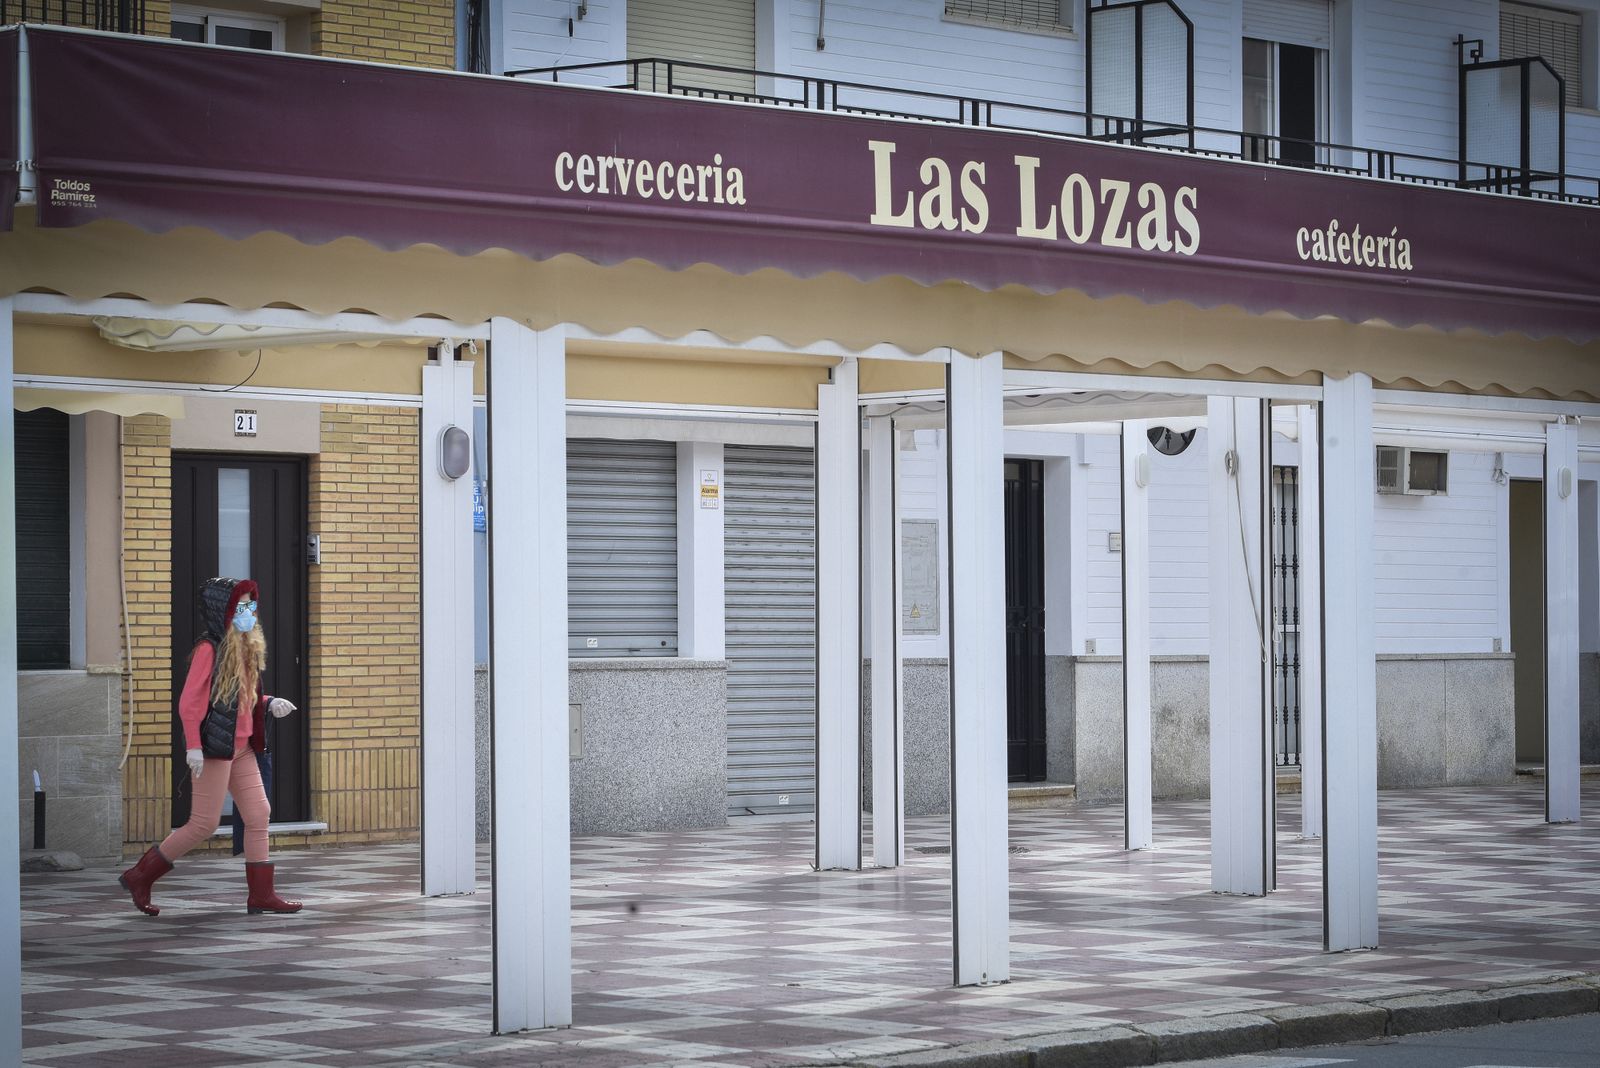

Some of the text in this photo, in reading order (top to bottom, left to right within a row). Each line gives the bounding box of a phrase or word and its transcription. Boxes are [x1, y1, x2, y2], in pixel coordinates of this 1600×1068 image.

[54, 179, 90, 191] Toldos
[555, 151, 747, 206] cerveceria
[51, 190, 95, 202] Ramírez
[868, 140, 1201, 256] Las Lozas
[1296, 219, 1413, 271] cafetería
[237, 415, 253, 430] 21
